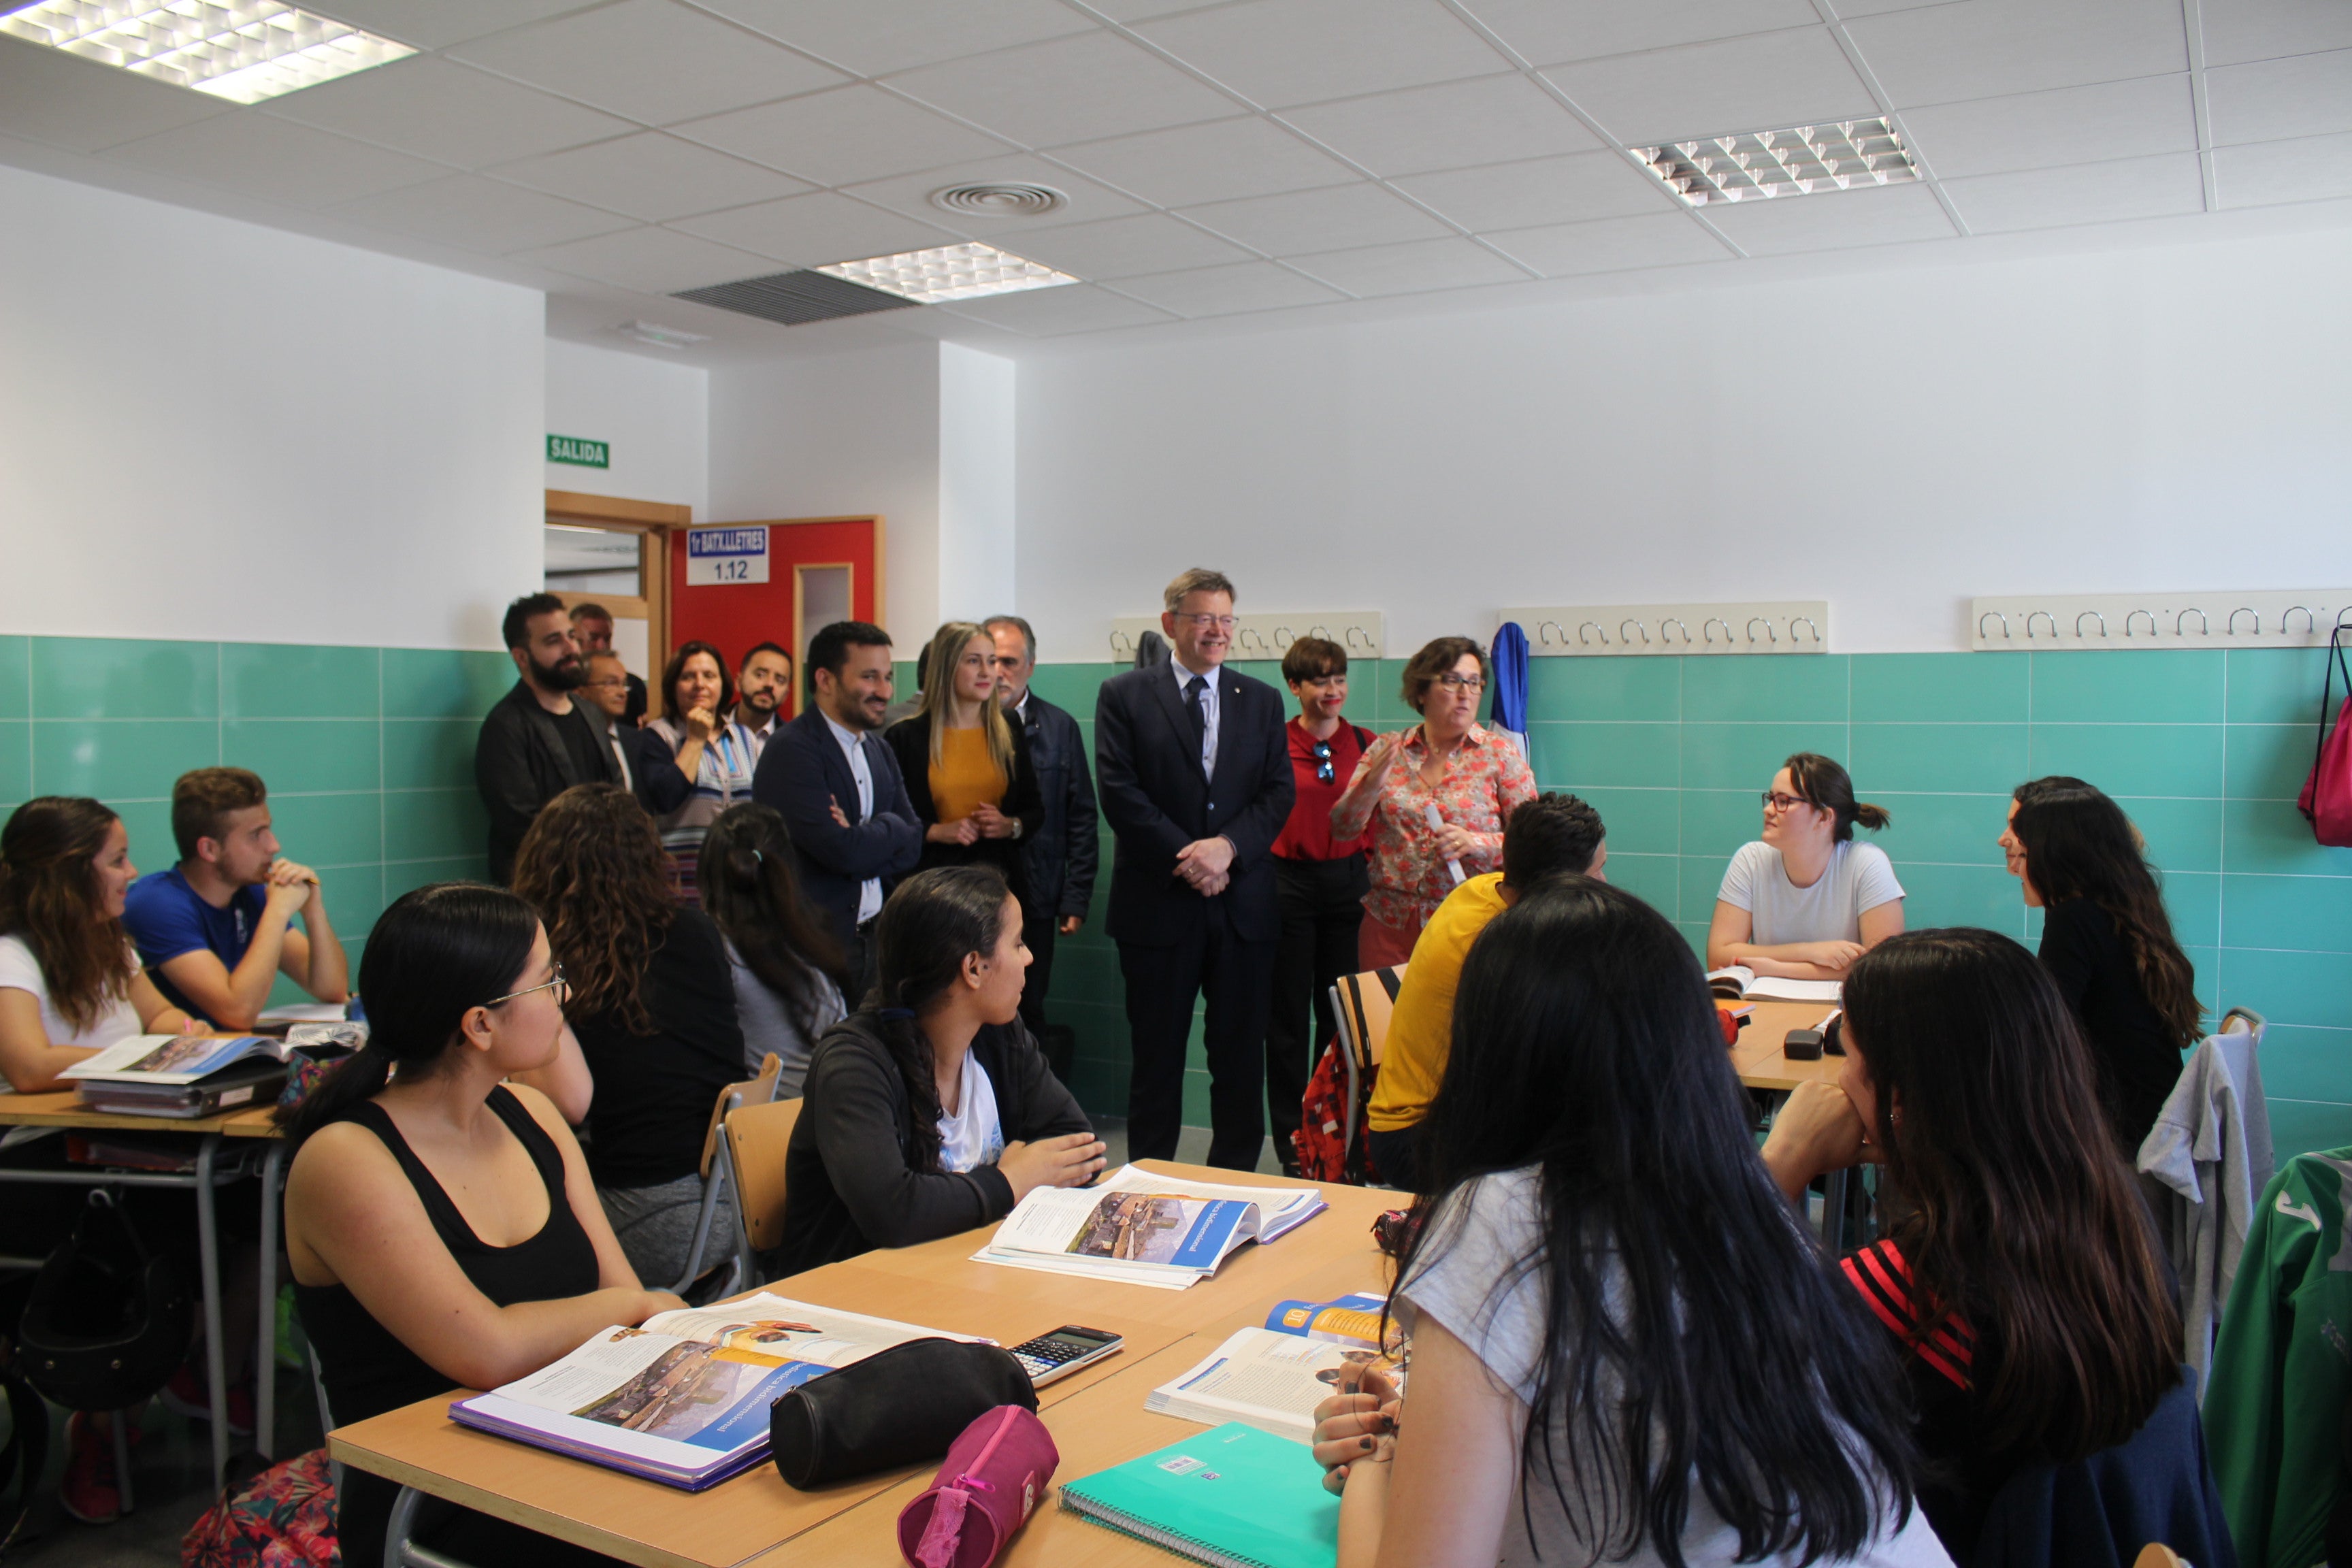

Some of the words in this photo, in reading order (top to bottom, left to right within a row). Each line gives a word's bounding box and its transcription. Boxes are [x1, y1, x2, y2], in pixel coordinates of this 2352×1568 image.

[551, 438, 605, 464] SALIDA
[715, 560, 747, 580] 1.12
[1287, 1309, 1305, 1324] 10
[717, 1384, 776, 1433] bidimensional
